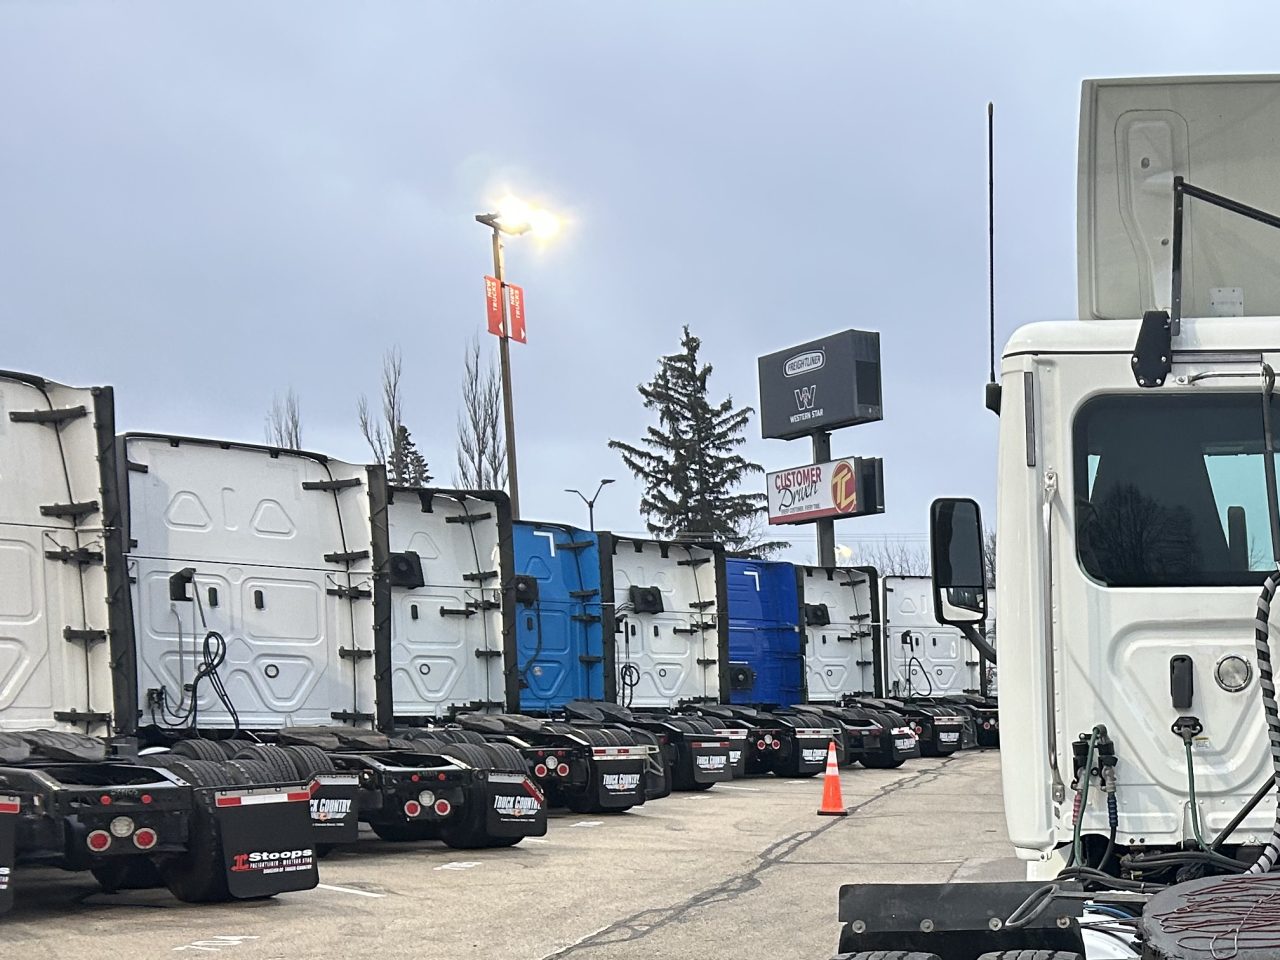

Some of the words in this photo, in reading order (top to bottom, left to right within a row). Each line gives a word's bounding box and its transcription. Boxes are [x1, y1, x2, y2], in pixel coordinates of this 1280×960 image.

[787, 354, 821, 372] FREIGHTLINER
[790, 411, 811, 423] WESTERN
[812, 408, 824, 418] STAR
[775, 466, 822, 491] CUSTOMER
[778, 480, 819, 511] Driven
[494, 795, 515, 809] TRUCK
[248, 848, 313, 862] Stoops
